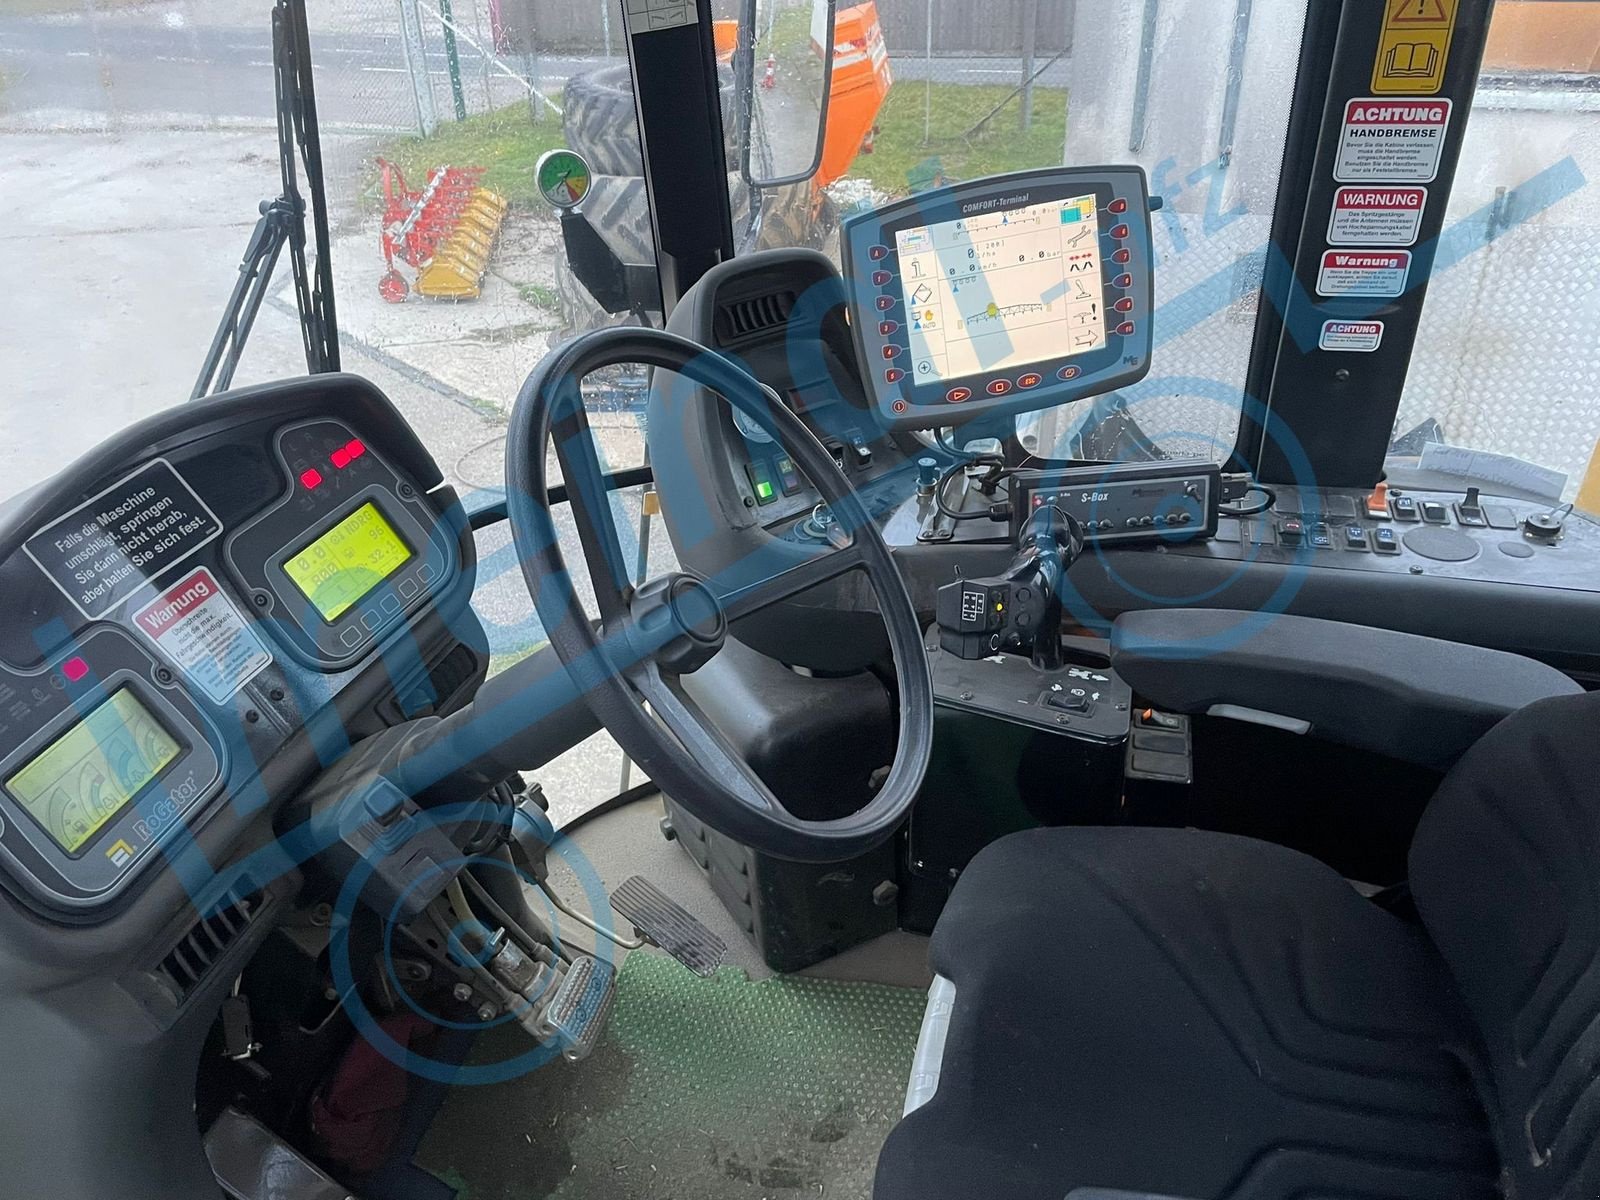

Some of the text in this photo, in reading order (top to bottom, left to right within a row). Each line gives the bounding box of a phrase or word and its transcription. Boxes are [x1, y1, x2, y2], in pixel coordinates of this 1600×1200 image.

[1351, 107, 1443, 121] ACHTUNG
[1349, 128, 1438, 138] HANDBREMSE
[962, 193, 1030, 213] COMFORT-Terminal
[1343, 193, 1419, 206] WARNUNG
[1335, 256, 1398, 267] Warnung
[1330, 324, 1377, 333] ACHTUNG
[1025, 376, 1035, 384] ESC
[1081, 492, 1110, 503] S-Box
[54, 486, 156, 552] Falls die Maschine
[65, 496, 173, 570] umschlägt, springen
[74, 509, 188, 584] Sie dann nicht herab,
[80, 583, 106, 604] aber
[103, 562, 135, 588] halten
[132, 550, 154, 568] Sie
[154, 532, 181, 554] sich
[178, 516, 206, 536] fest.
[144, 580, 210, 630] Warnung
[132, 776, 198, 842] RoGator
